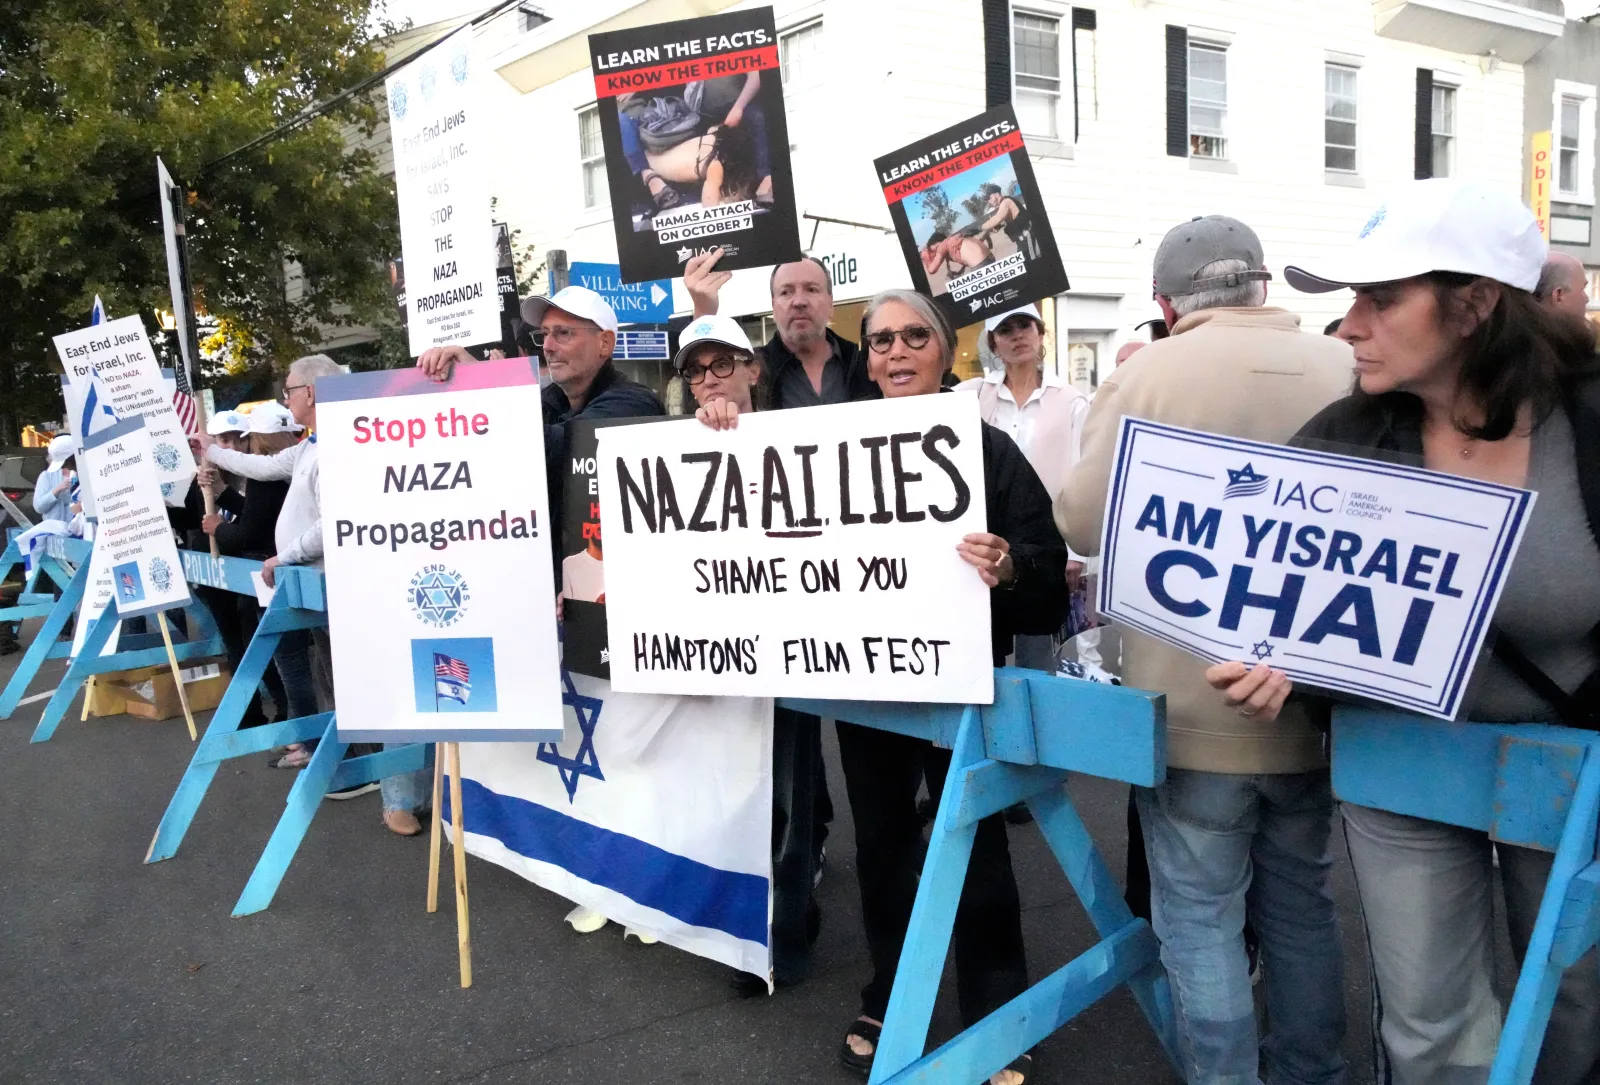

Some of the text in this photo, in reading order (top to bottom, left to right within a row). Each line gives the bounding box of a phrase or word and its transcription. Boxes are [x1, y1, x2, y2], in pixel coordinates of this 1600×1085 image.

[597, 28, 772, 70] LEARN THE FACTS.
[607, 55, 767, 90] KNOW THE TRUTH.
[423, 119, 440, 143] End
[442, 110, 466, 134] Jews
[450, 143, 467, 160] Inc.
[882, 120, 1015, 183] LEARN THE FACTS.
[893, 142, 1014, 196] KNOW THE TRUTH.
[427, 178, 449, 199] SAYS
[430, 205, 453, 227] STOP
[655, 202, 753, 229] HAMAS ATTACK
[660, 217, 751, 242] ON OCTOBER 7
[435, 233, 453, 253] THE
[433, 260, 458, 282] NAZA
[948, 253, 1023, 290] HAMAS ATTACK
[954, 265, 1025, 300] ON OCTOBER 7
[417, 281, 483, 313] PROPAGANDA!
[601, 295, 647, 311] RKING
[983, 292, 1004, 308] IAC
[65, 332, 140, 359] East End Jews
[74, 351, 146, 377] for srael, Inc.
[105, 375, 115, 384] NO
[115, 383, 131, 392] sham
[141, 389, 154, 397] with
[156, 406, 173, 416] Israel
[150, 428, 172, 438] Forces.
[353, 407, 489, 448] Stop the
[103, 463, 114, 477] gift
[113, 461, 119, 470] to
[120, 453, 143, 468] Hamas!
[383, 461, 473, 494] NAZA
[838, 424, 971, 526] LIES
[1273, 477, 1339, 514] IAC
[1348, 500, 1392, 514] AMERICAN
[131, 506, 150, 517] Sources
[138, 514, 165, 528] Distortions
[1346, 508, 1383, 521] COUNCIL
[336, 510, 539, 552] Propaganda!
[113, 550, 129, 561] against
[1134, 494, 1464, 598] AM YISRAEL
[183, 552, 228, 588] POLICE
[693, 556, 908, 595] SHAME ON YOU
[407, 564, 471, 603] EAST END JEWS
[434, 607, 468, 628] ISRAEL
[1145, 549, 1436, 667] CHAI
[783, 637, 851, 675] FILM
[861, 636, 951, 677] FEST
